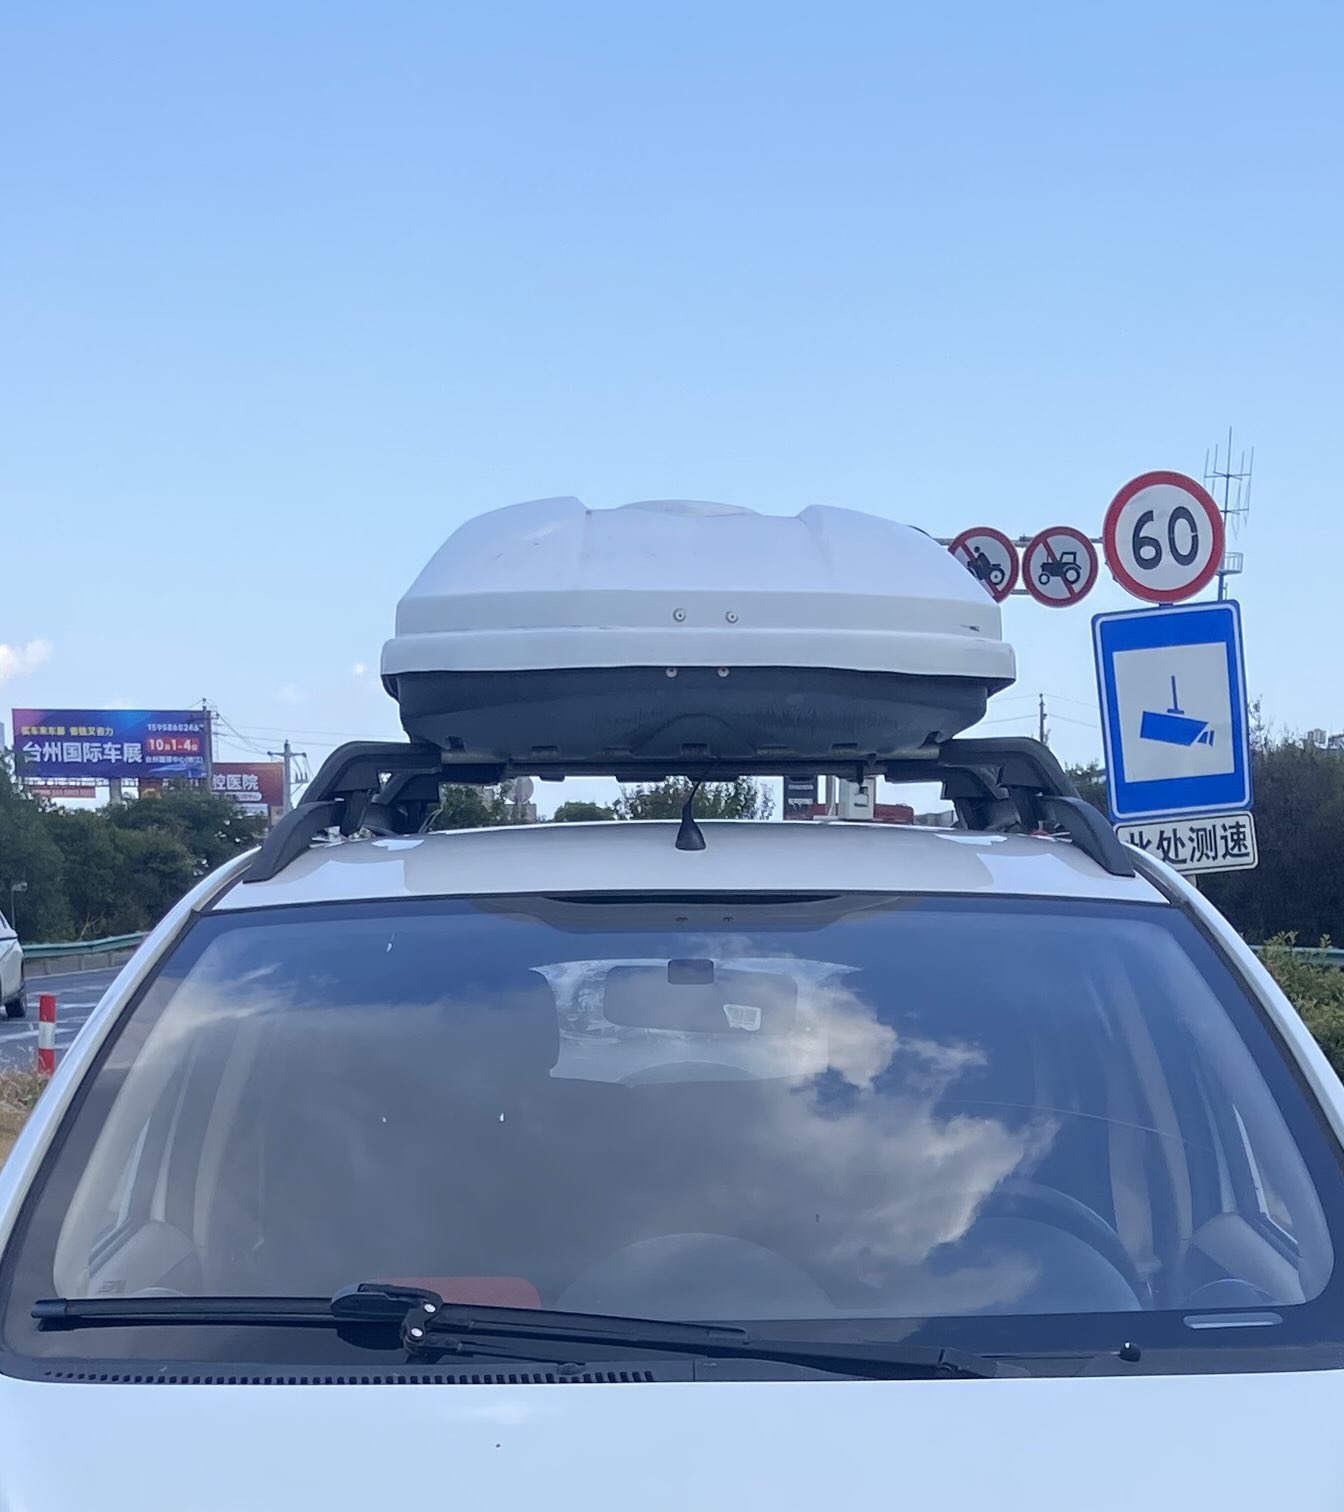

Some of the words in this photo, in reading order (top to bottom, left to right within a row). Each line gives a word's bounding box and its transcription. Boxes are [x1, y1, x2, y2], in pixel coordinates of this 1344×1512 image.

[1132, 505, 1199, 570] 60
[22, 741, 143, 764] 台州国际车展
